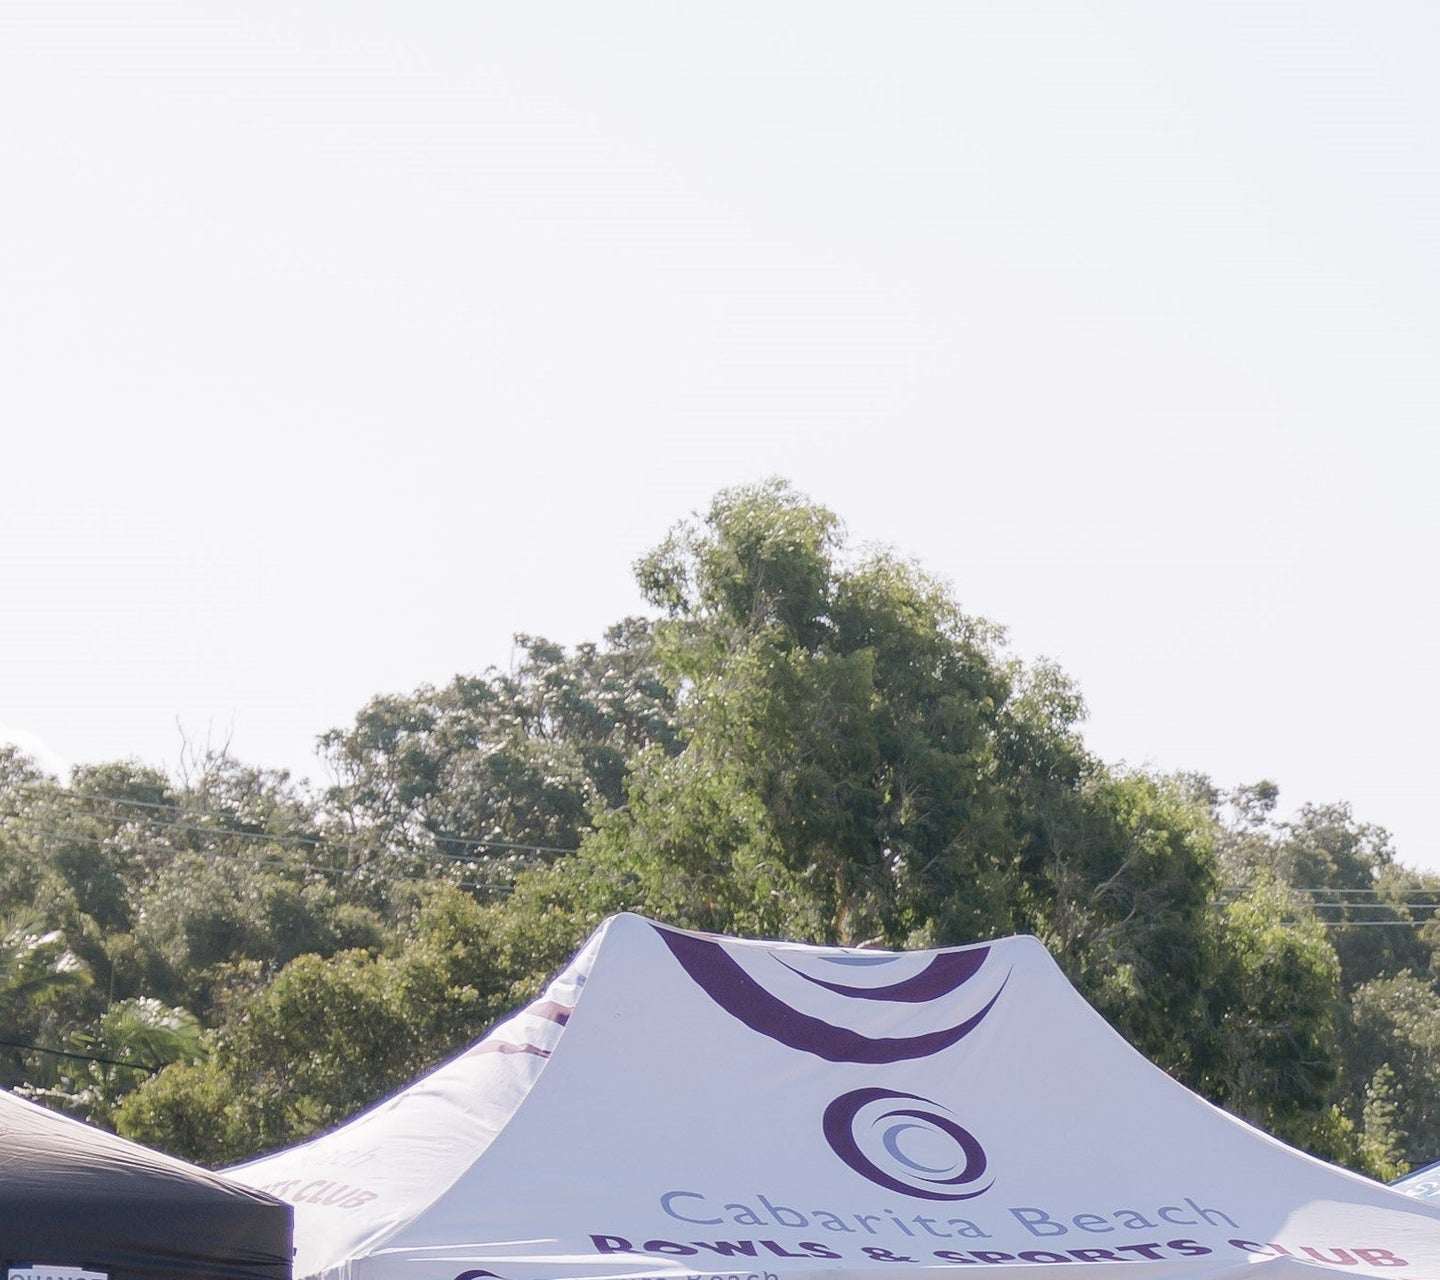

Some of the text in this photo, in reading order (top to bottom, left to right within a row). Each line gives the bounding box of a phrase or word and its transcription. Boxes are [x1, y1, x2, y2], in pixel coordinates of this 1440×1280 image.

[291, 1179, 378, 1210] CLUB
[660, 1190, 1240, 1239] Cabarita Beach
[860, 1246, 921, 1263] &
